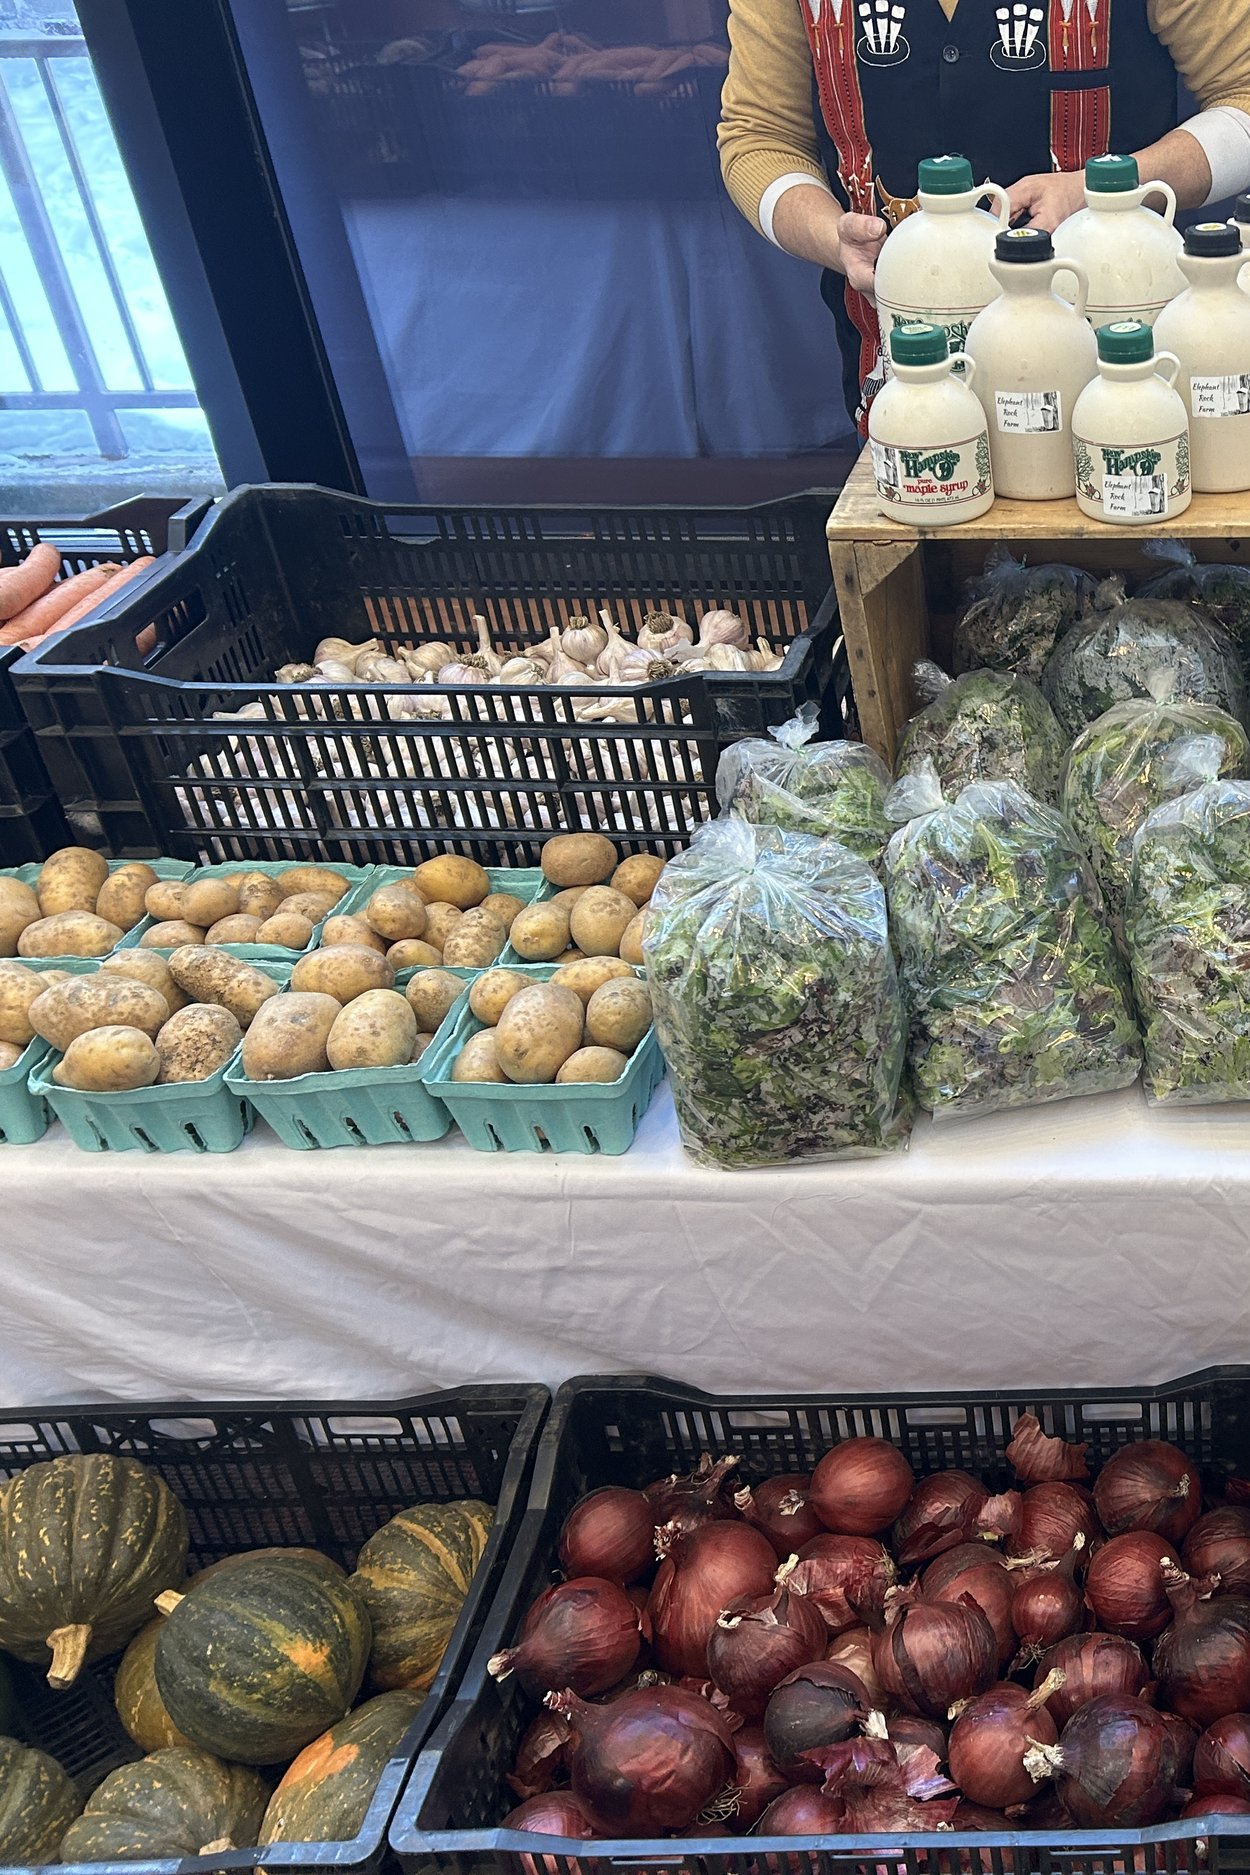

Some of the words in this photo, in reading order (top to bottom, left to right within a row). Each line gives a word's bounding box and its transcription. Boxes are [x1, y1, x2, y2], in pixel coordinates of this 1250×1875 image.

[1193, 382, 1220, 392] Elephant
[997, 397, 1023, 406] Elephant
[1198, 394, 1214, 402] Rock
[1003, 409, 1018, 417] Rock
[1199, 405, 1215, 413] Farm
[898, 450, 923, 463] New
[1100, 448, 1125, 461] New
[903, 484, 938, 496] maple
[940, 480, 968, 496] syrup
[1104, 481, 1131, 491] Elephant
[1109, 492, 1125, 501] Rock
